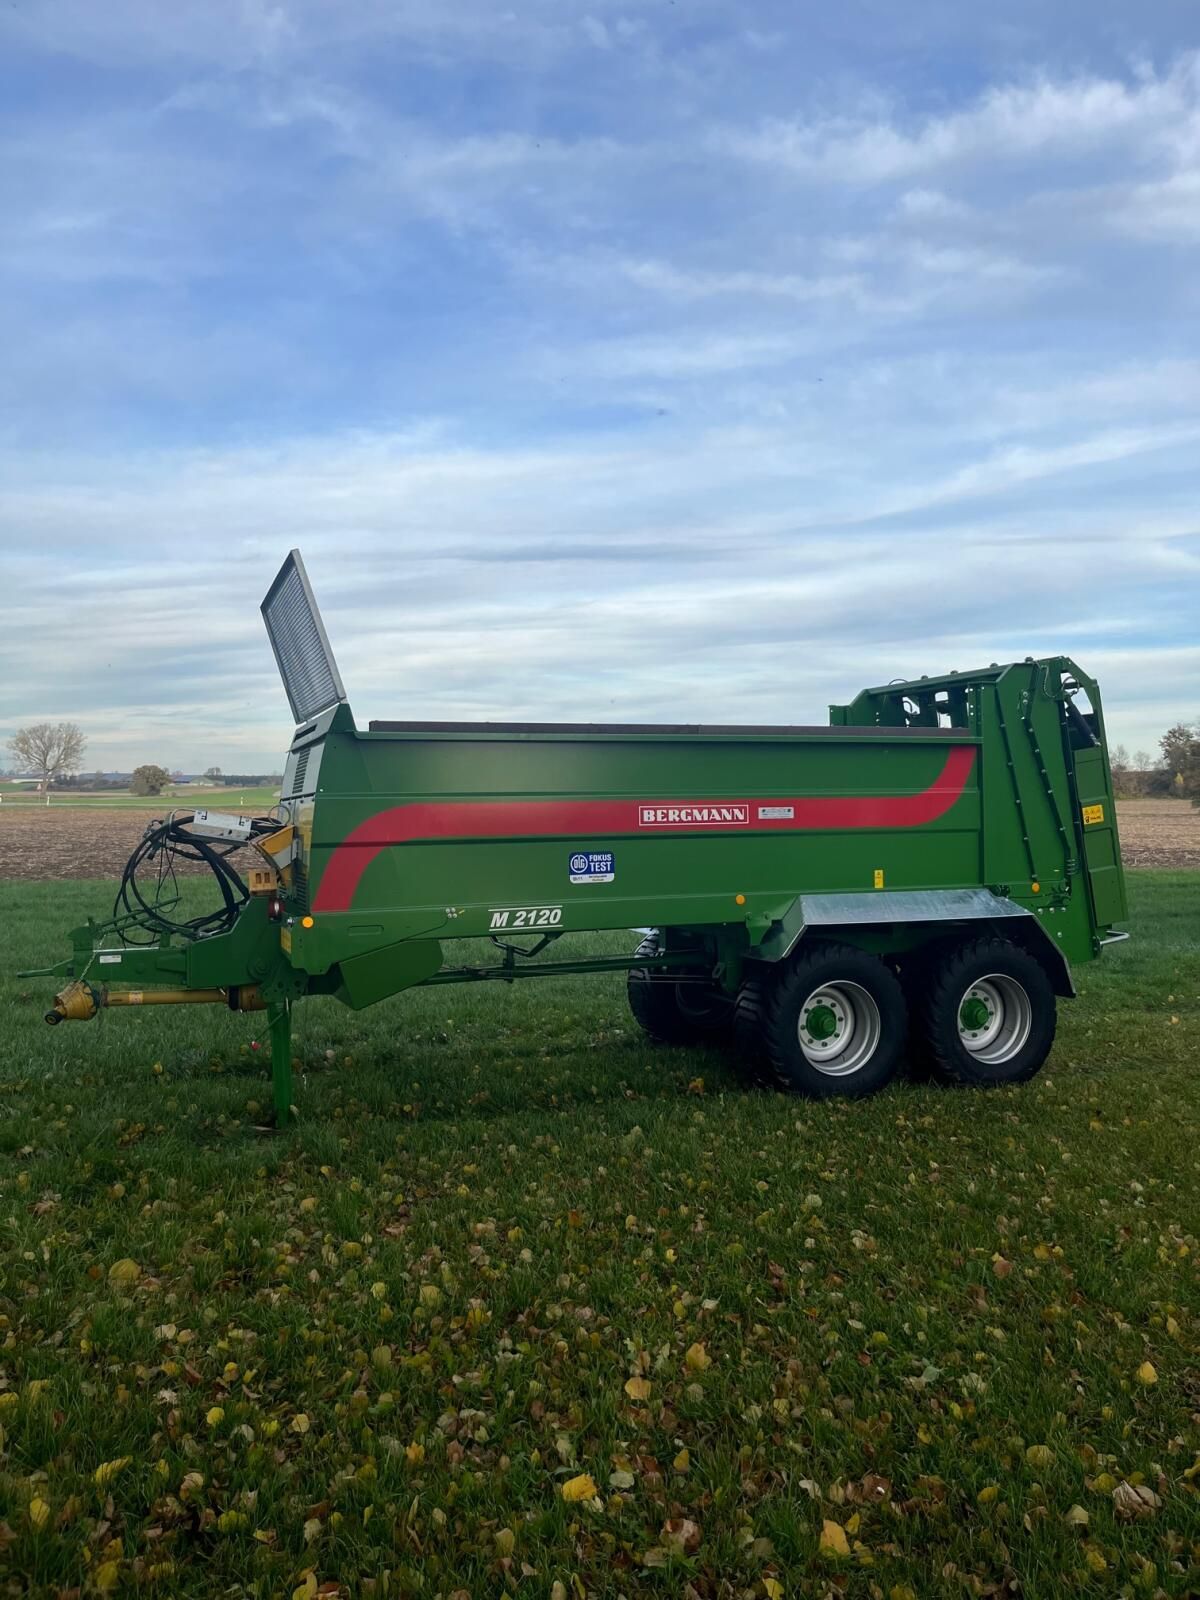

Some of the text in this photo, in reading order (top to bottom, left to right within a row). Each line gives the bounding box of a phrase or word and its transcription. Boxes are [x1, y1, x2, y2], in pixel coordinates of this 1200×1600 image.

[642, 808, 745, 822] BERGMANN
[589, 854, 612, 862] FOKUS
[589, 861, 612, 872] TEST
[490, 908, 562, 928] M 2120
